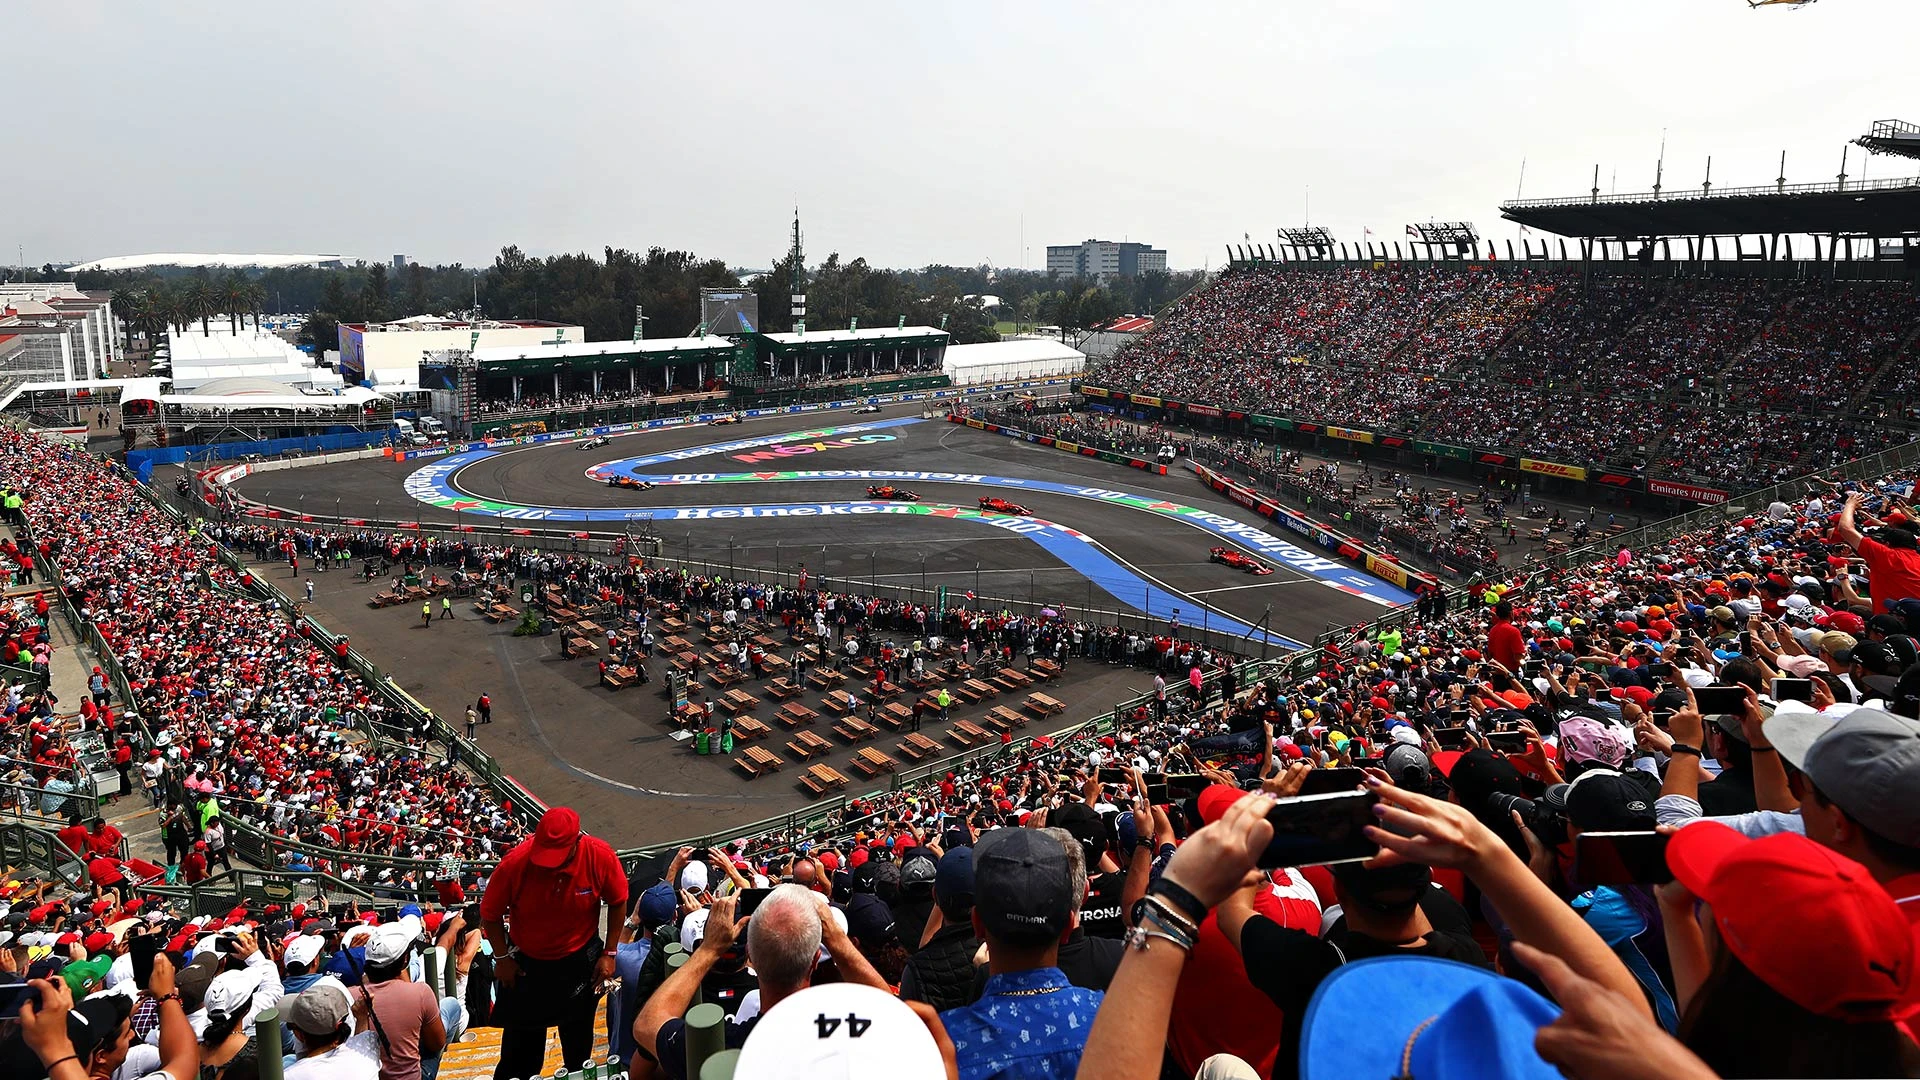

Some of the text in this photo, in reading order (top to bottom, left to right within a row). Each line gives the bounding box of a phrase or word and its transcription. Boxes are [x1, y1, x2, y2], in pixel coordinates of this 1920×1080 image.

[550, 431, 576, 439] Heineken
[608, 424, 632, 432] Heineken
[487, 440, 515, 448] Heineken
[416, 448, 447, 457] Heineken
[1530, 460, 1569, 475] DHL
[794, 469, 988, 483] Heineken
[1650, 483, 1726, 503] Emirates FLY BETTER
[672, 503, 910, 520] Heineken
[1286, 517, 1310, 536] Heineken
[1184, 510, 1349, 573] Heineken
[1373, 560, 1399, 582] PIRELLI
[1006, 913, 1048, 924] BATMAN
[814, 1012, 872, 1039] 44
